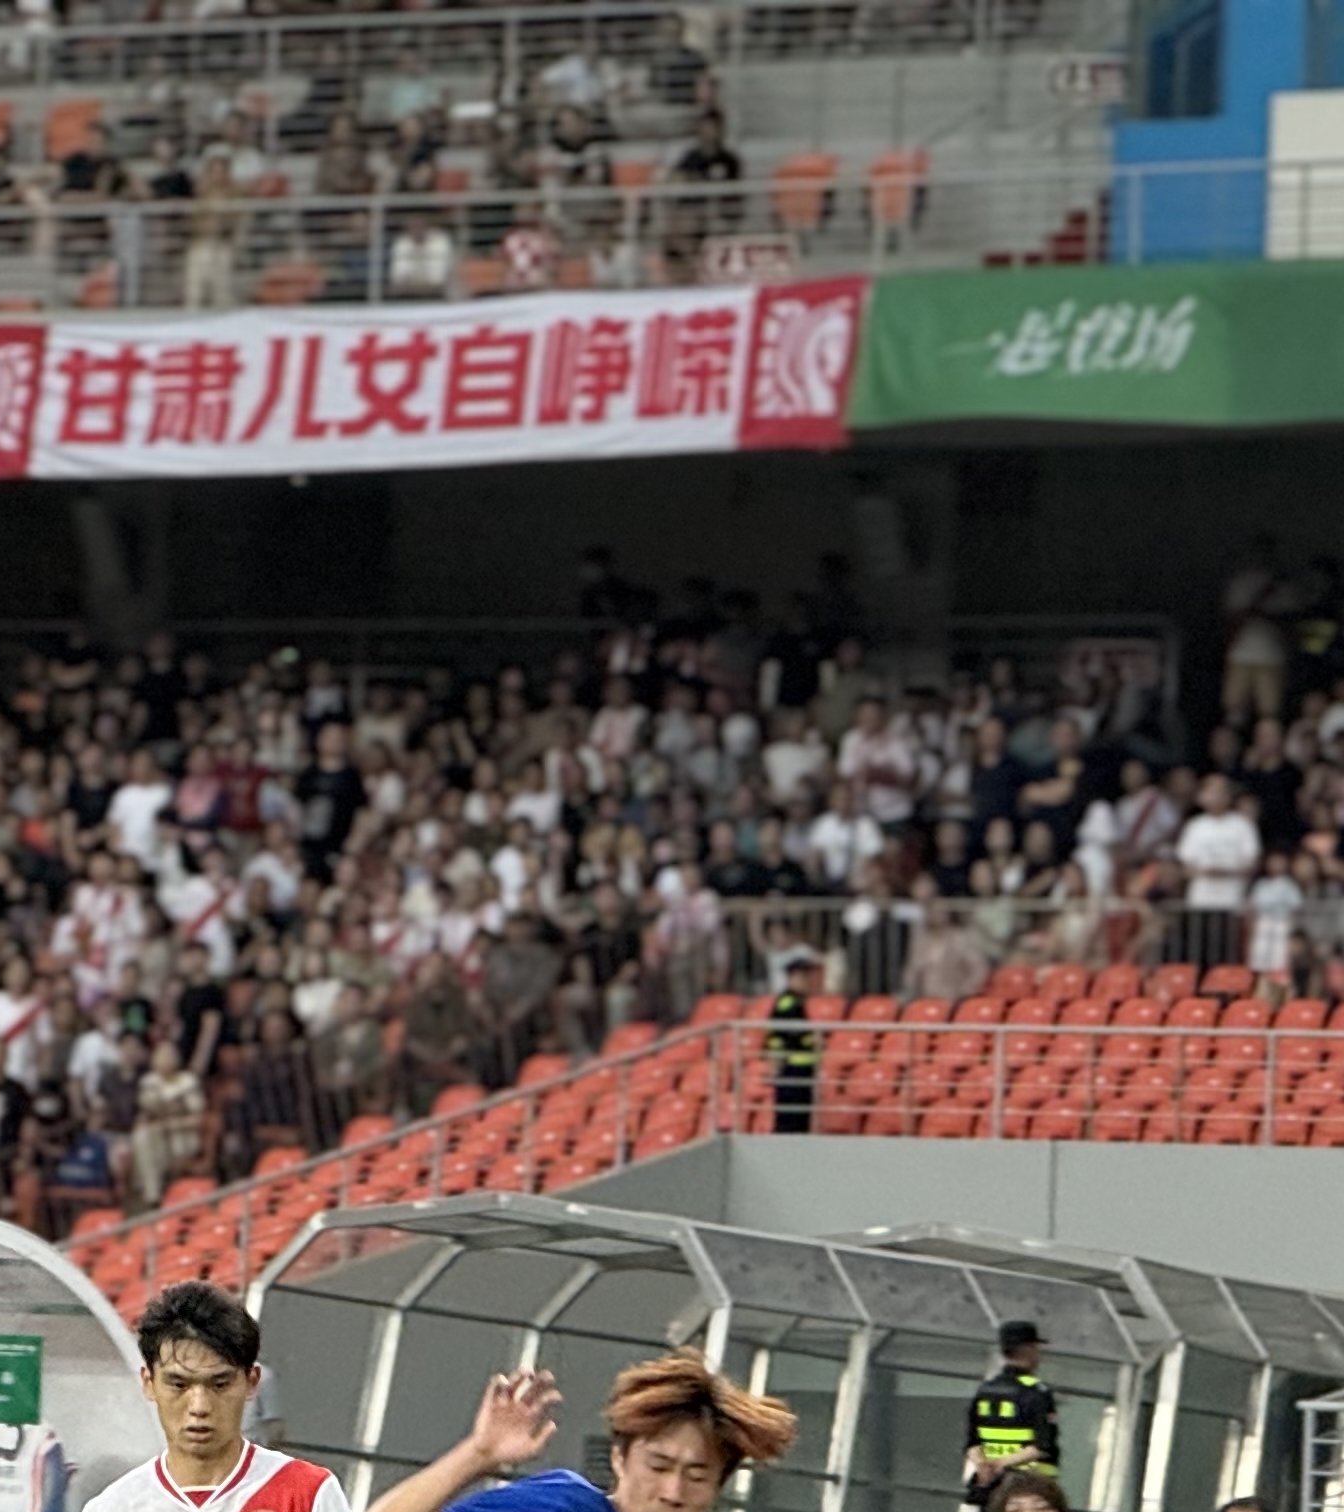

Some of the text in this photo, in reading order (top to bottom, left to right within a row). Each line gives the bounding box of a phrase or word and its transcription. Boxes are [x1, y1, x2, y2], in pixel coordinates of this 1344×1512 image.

[58, 309, 738, 447] 甘肃儿女自峥嵘
